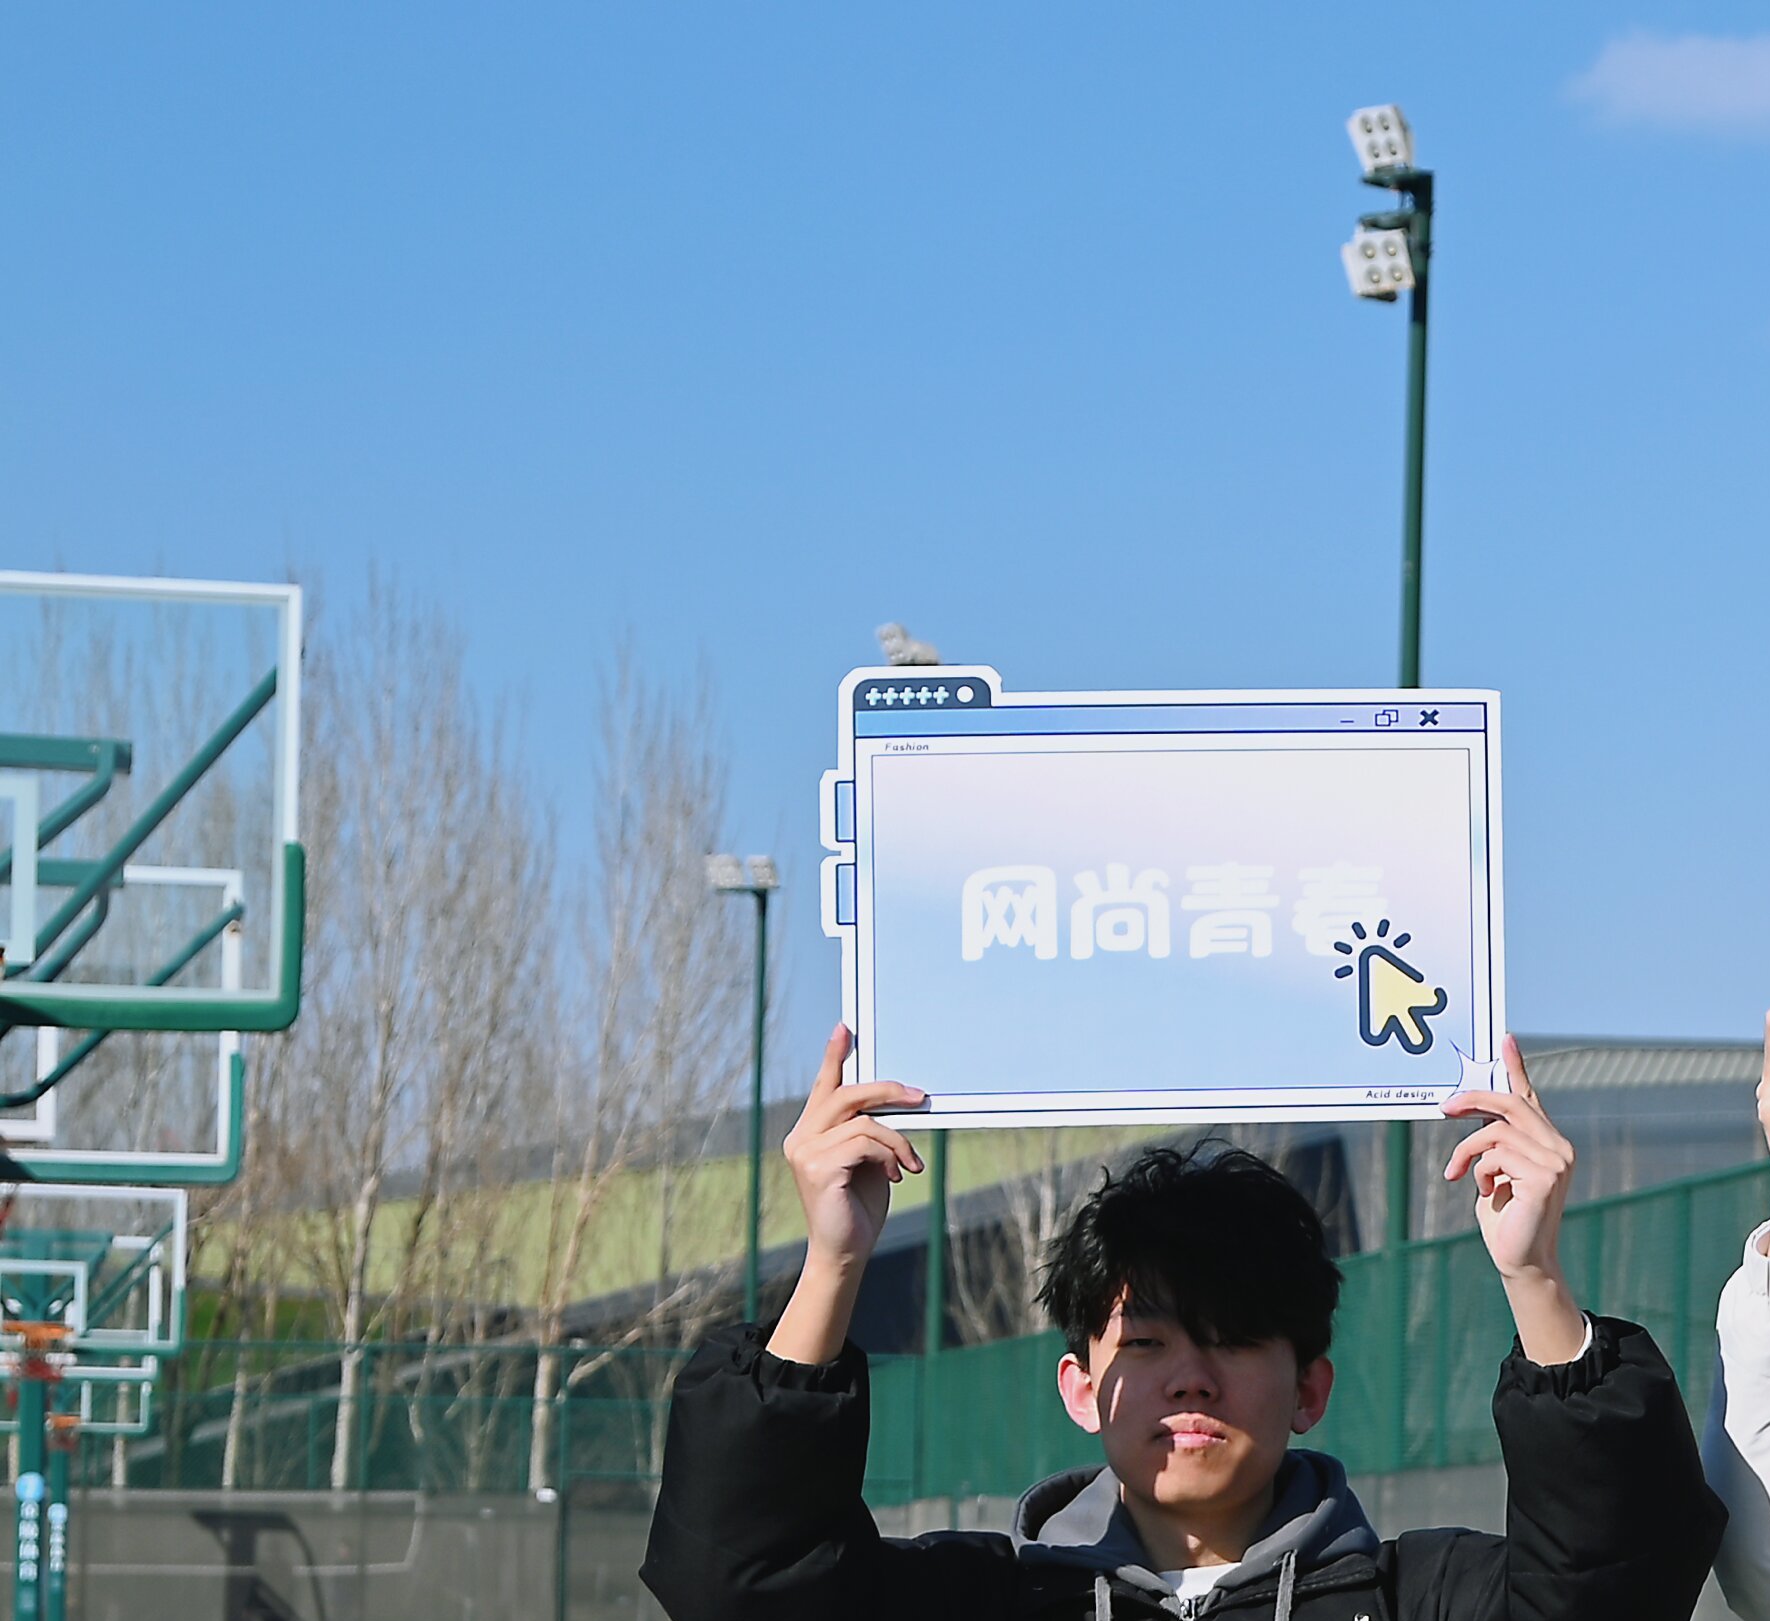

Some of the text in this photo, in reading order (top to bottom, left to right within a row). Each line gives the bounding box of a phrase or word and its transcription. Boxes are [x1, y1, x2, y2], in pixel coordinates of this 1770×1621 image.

[884, 742, 930, 752] Fashion
[961, 861, 1388, 962] 网尚青春
[1365, 1089, 1435, 1100] Acid design
